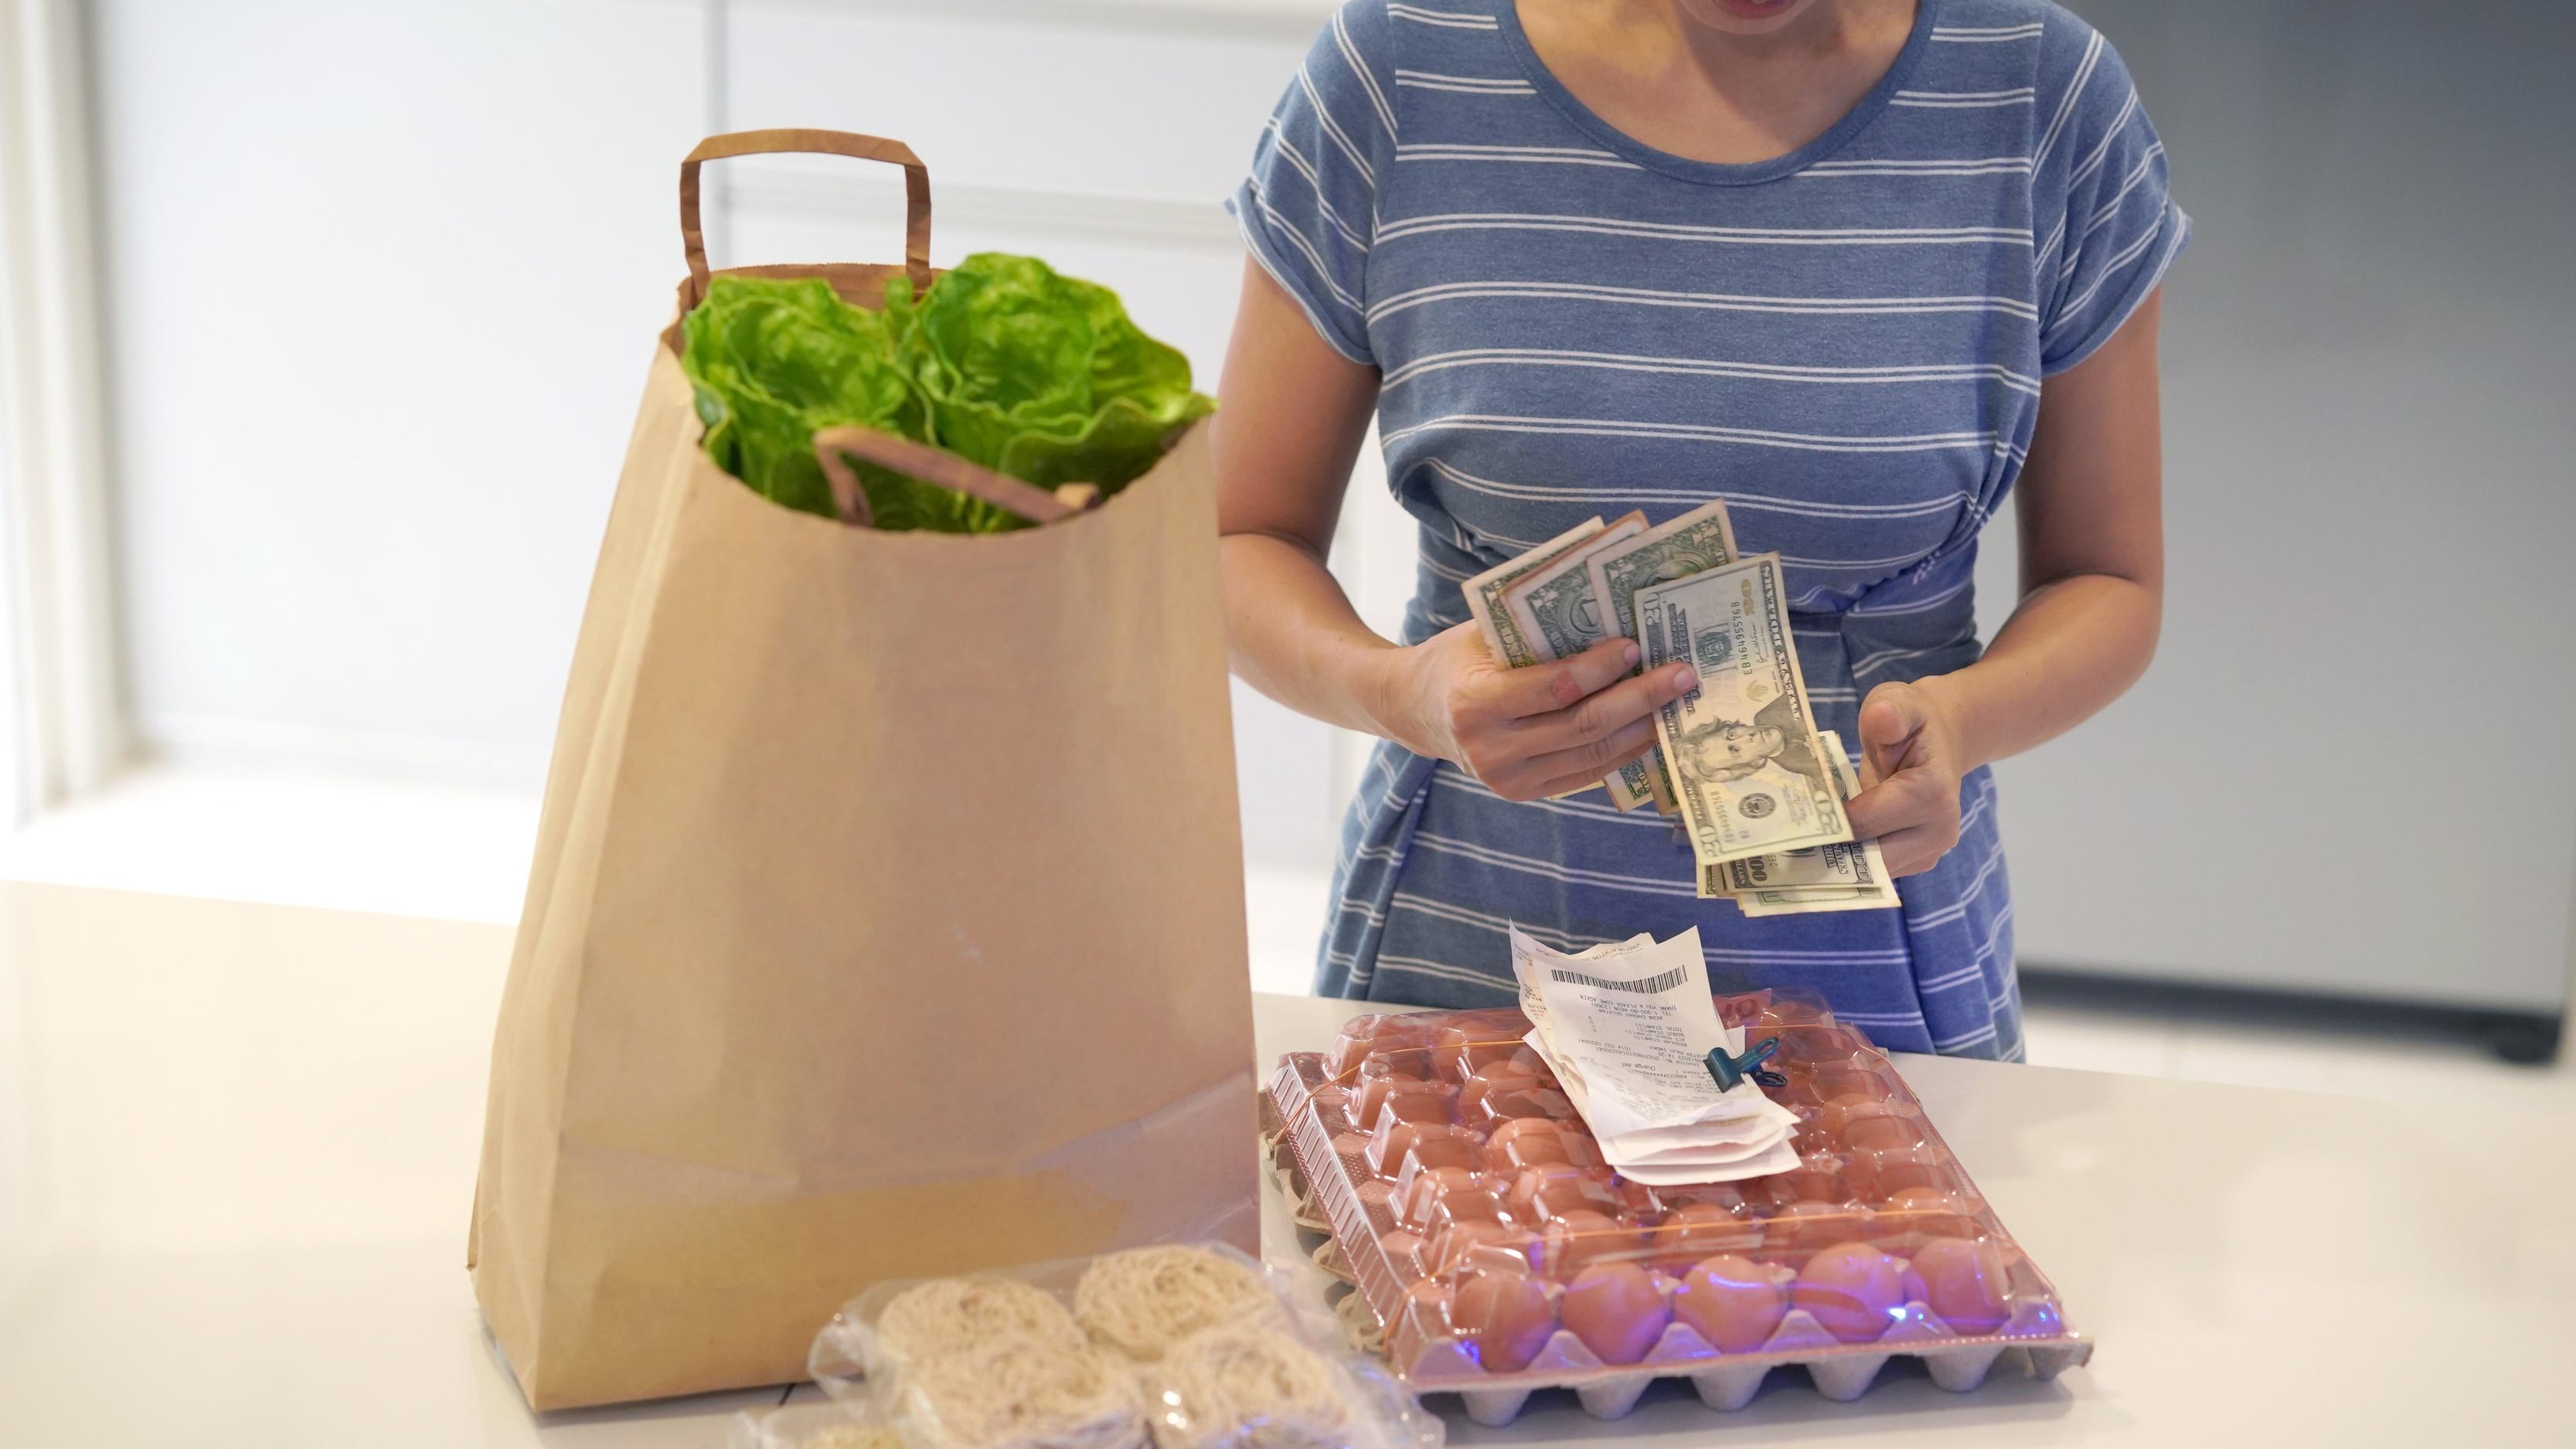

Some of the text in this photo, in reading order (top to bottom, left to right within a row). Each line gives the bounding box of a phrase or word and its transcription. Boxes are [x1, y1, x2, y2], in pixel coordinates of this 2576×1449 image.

[1641, 590, 1663, 624] 20
[1737, 577, 1757, 616] 20
[1759, 563, 1784, 645] DOLLARS
[1815, 787, 1842, 835] 20
[1698, 823, 1722, 857] 20
